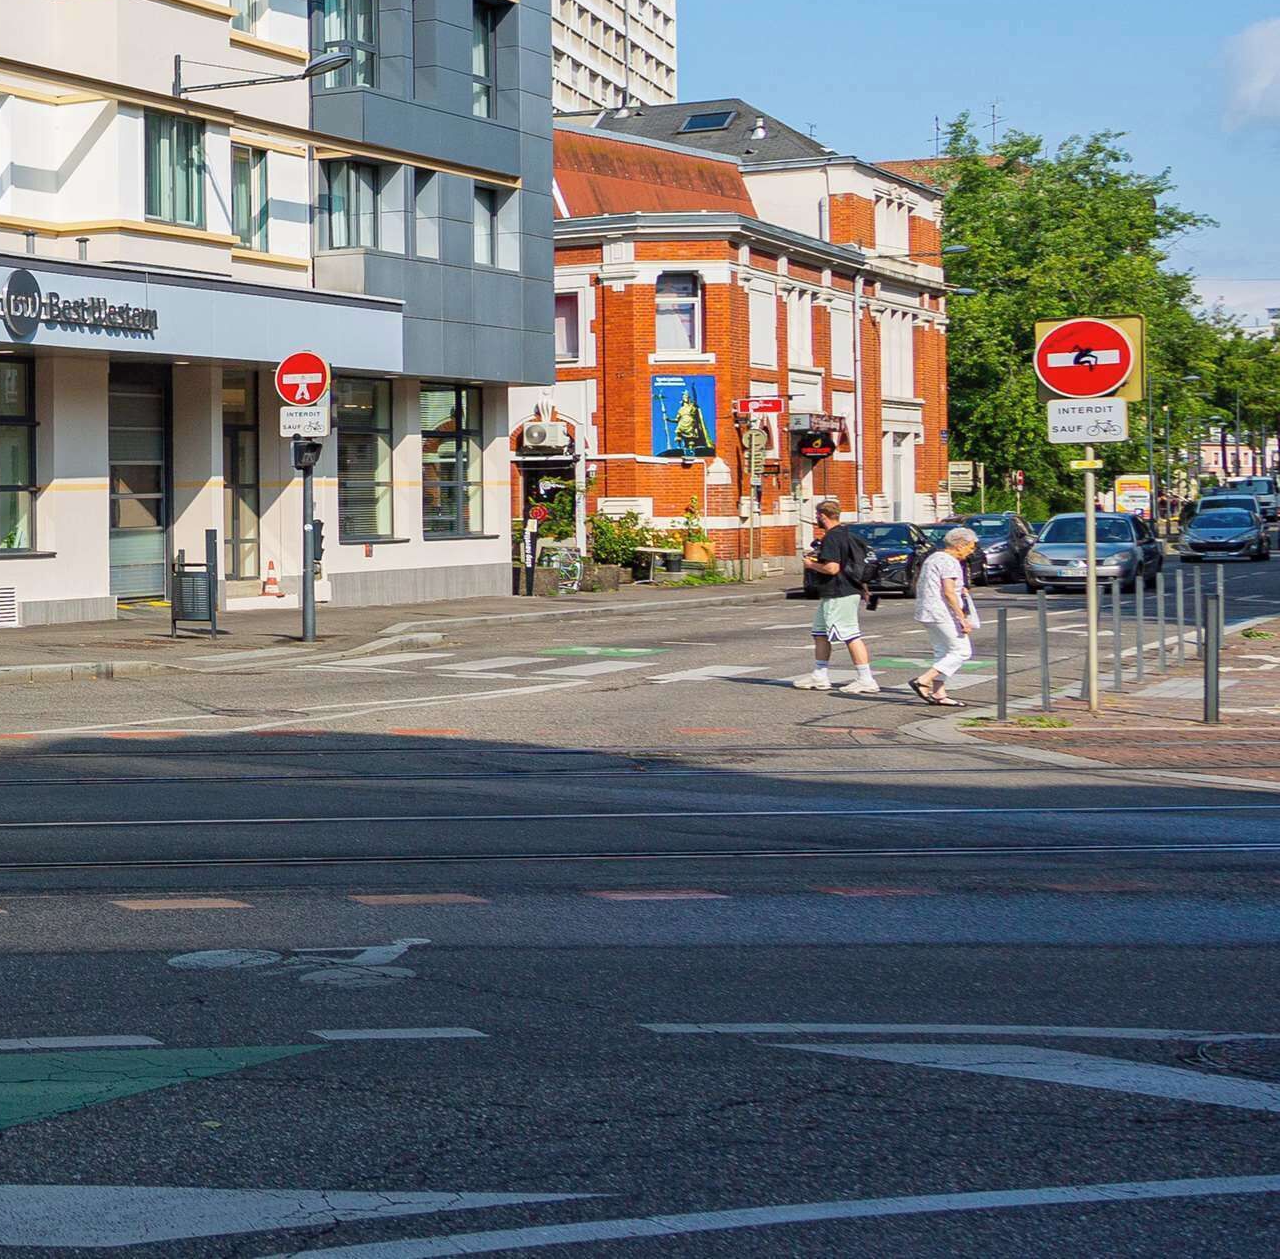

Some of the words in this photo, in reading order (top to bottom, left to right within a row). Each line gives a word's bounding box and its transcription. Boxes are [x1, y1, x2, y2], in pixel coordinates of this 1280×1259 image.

[48, 291, 90, 322] Best
[90, 296, 159, 331] Western
[1057, 405, 1114, 415] INTERDIT
[1051, 424, 1084, 434] SAUF
